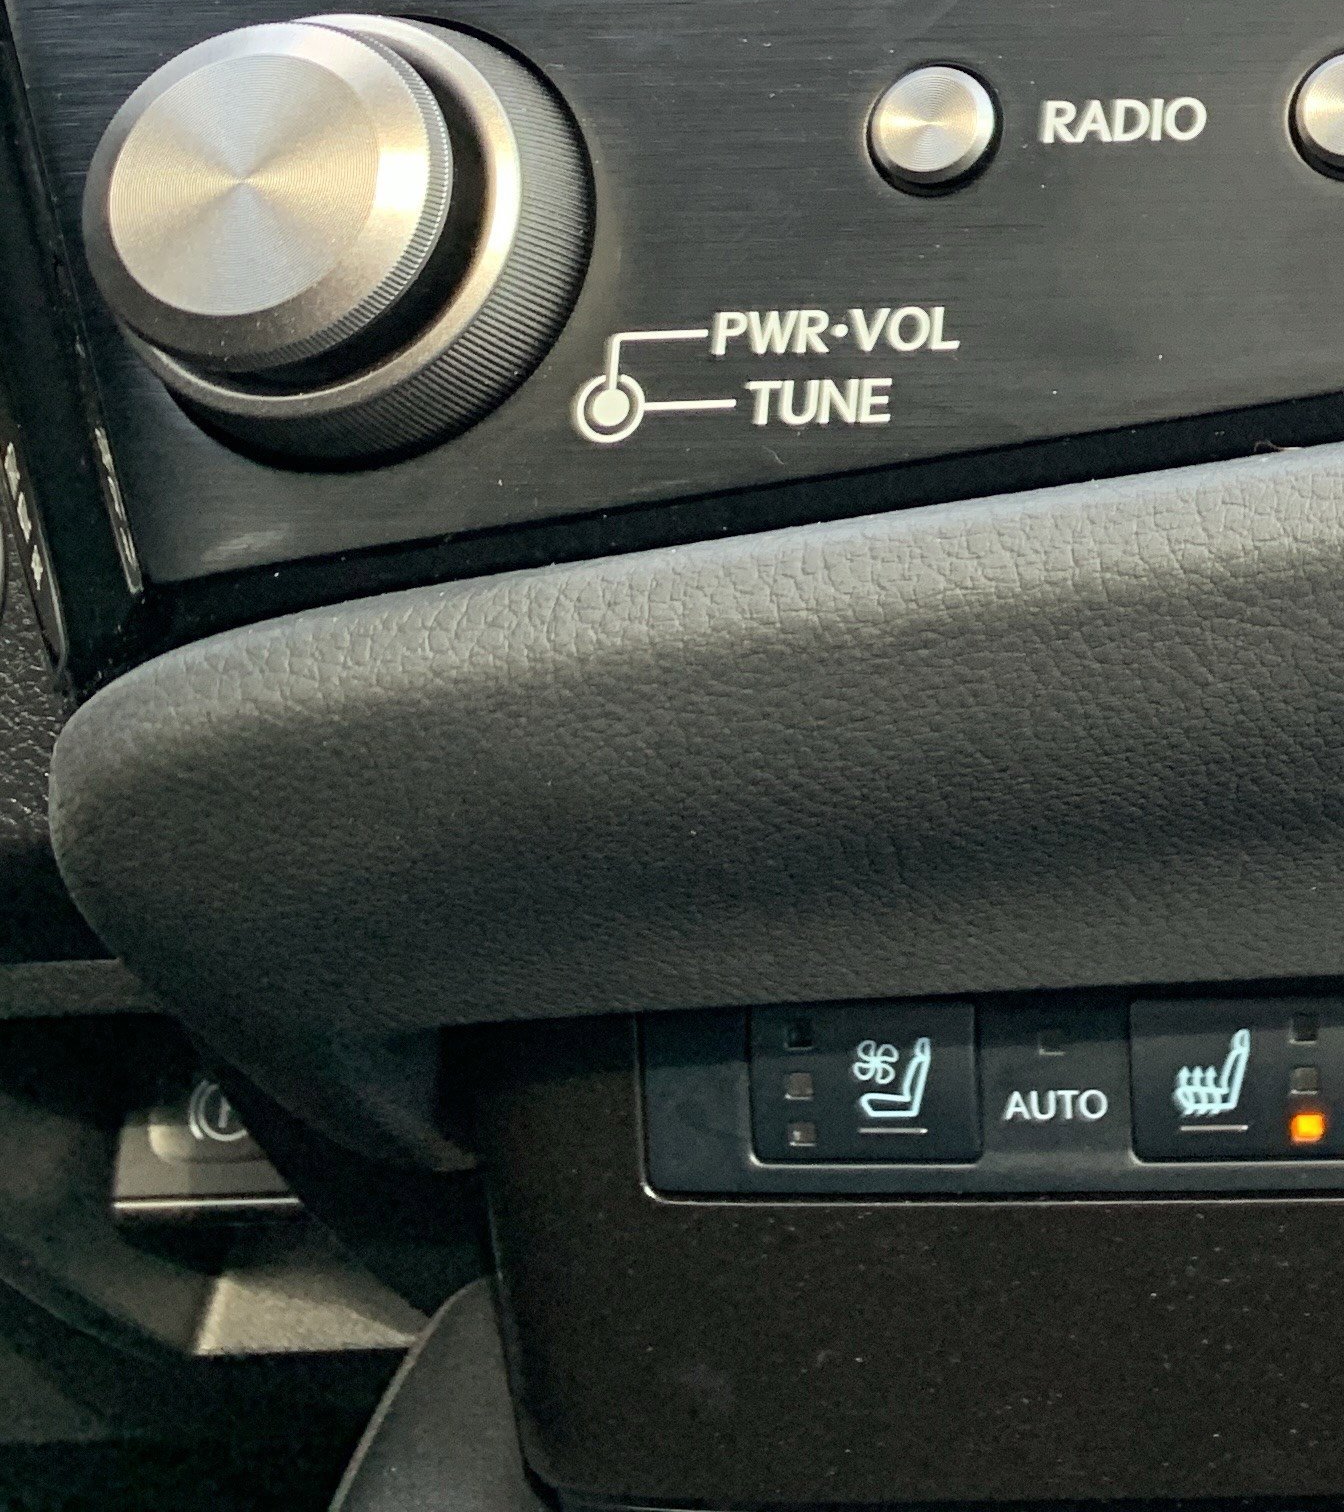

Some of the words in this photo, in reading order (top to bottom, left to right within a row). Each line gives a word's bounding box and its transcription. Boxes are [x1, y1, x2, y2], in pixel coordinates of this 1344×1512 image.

[1041, 96, 1207, 144] RADIO
[745, 376, 892, 425] TUNE
[1004, 1087, 1108, 1122] AUTO
